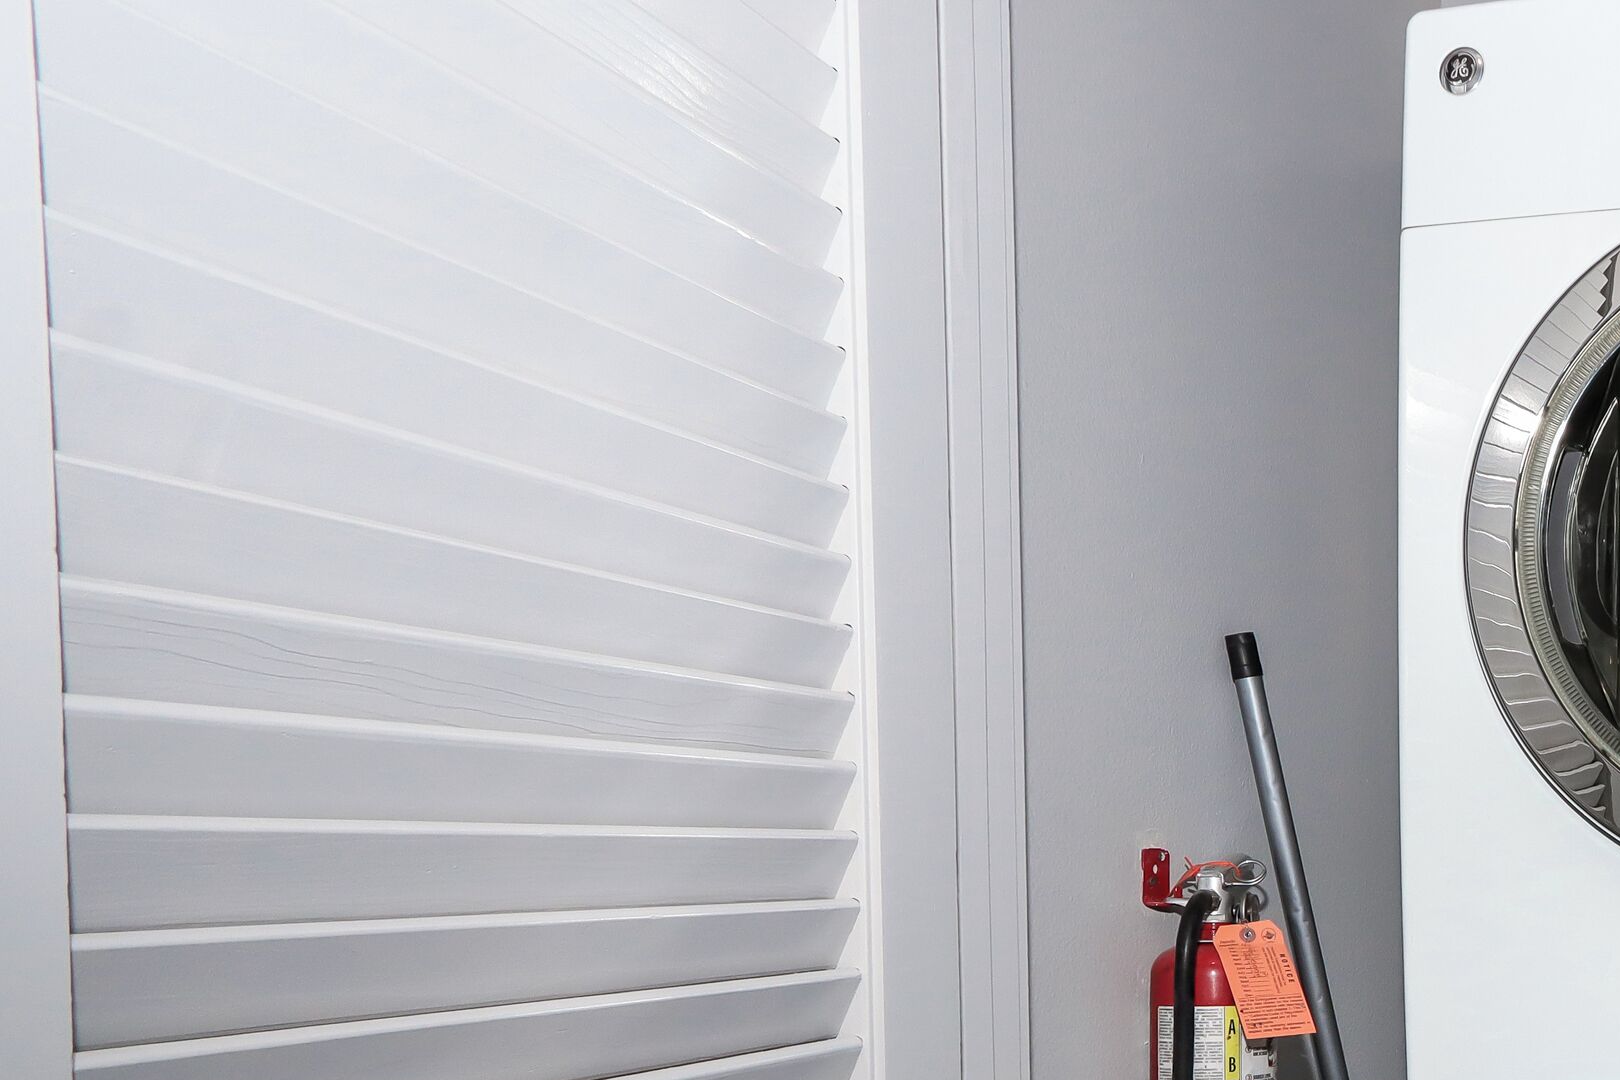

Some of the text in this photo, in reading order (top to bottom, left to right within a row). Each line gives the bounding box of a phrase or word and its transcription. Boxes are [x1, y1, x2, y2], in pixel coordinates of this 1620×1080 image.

[1279, 953, 1296, 984] NOTICE
[1228, 1018, 1236, 1035] A
[1228, 1056, 1236, 1073] B
